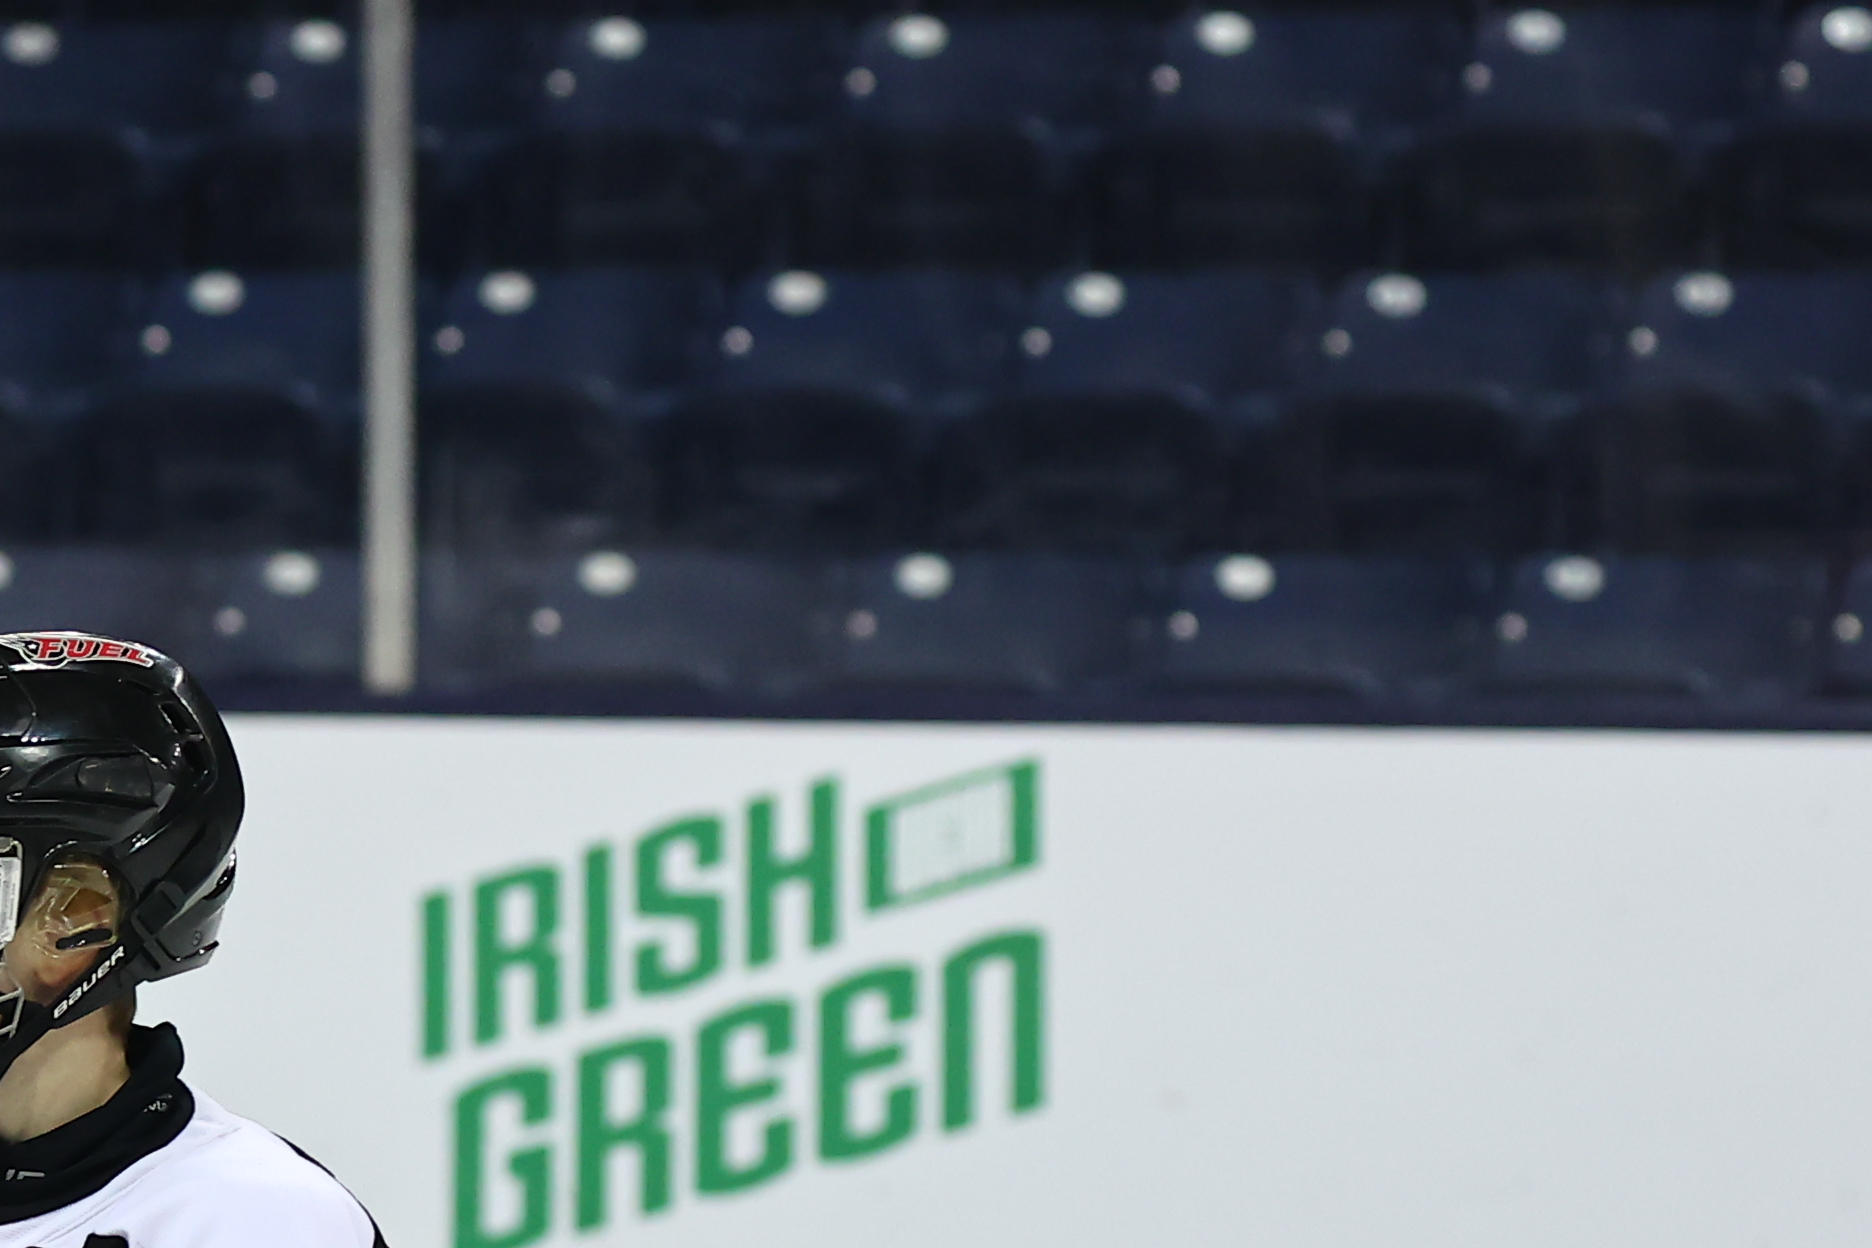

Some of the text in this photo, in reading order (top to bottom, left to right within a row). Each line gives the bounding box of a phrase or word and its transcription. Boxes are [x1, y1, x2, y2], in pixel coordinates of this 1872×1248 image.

[34, 637, 154, 668] FUEL
[419, 773, 839, 1064] IRISH
[53, 944, 125, 1021] BAUER
